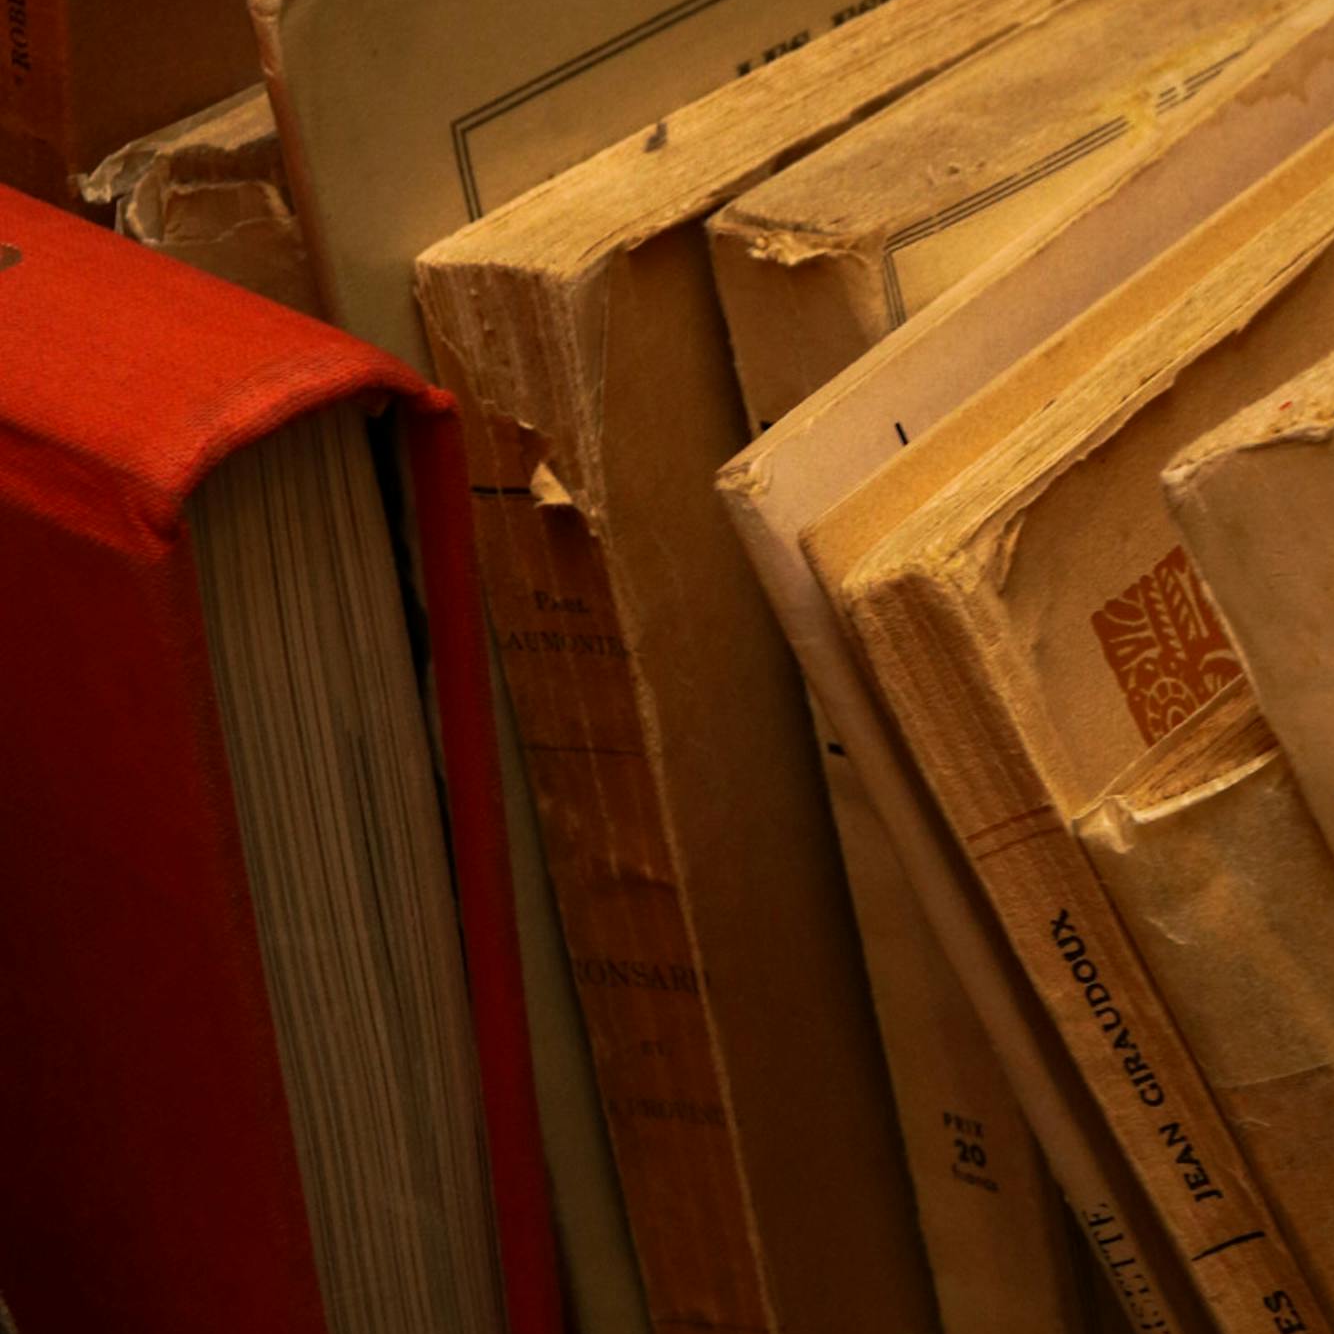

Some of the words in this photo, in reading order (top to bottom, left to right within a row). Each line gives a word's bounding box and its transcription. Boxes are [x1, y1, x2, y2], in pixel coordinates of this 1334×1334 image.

[1050, 909, 1166, 1108] GIRAUDOUX
[953, 1138, 987, 1167] 20
[1159, 1122, 1224, 1203] JEAN
